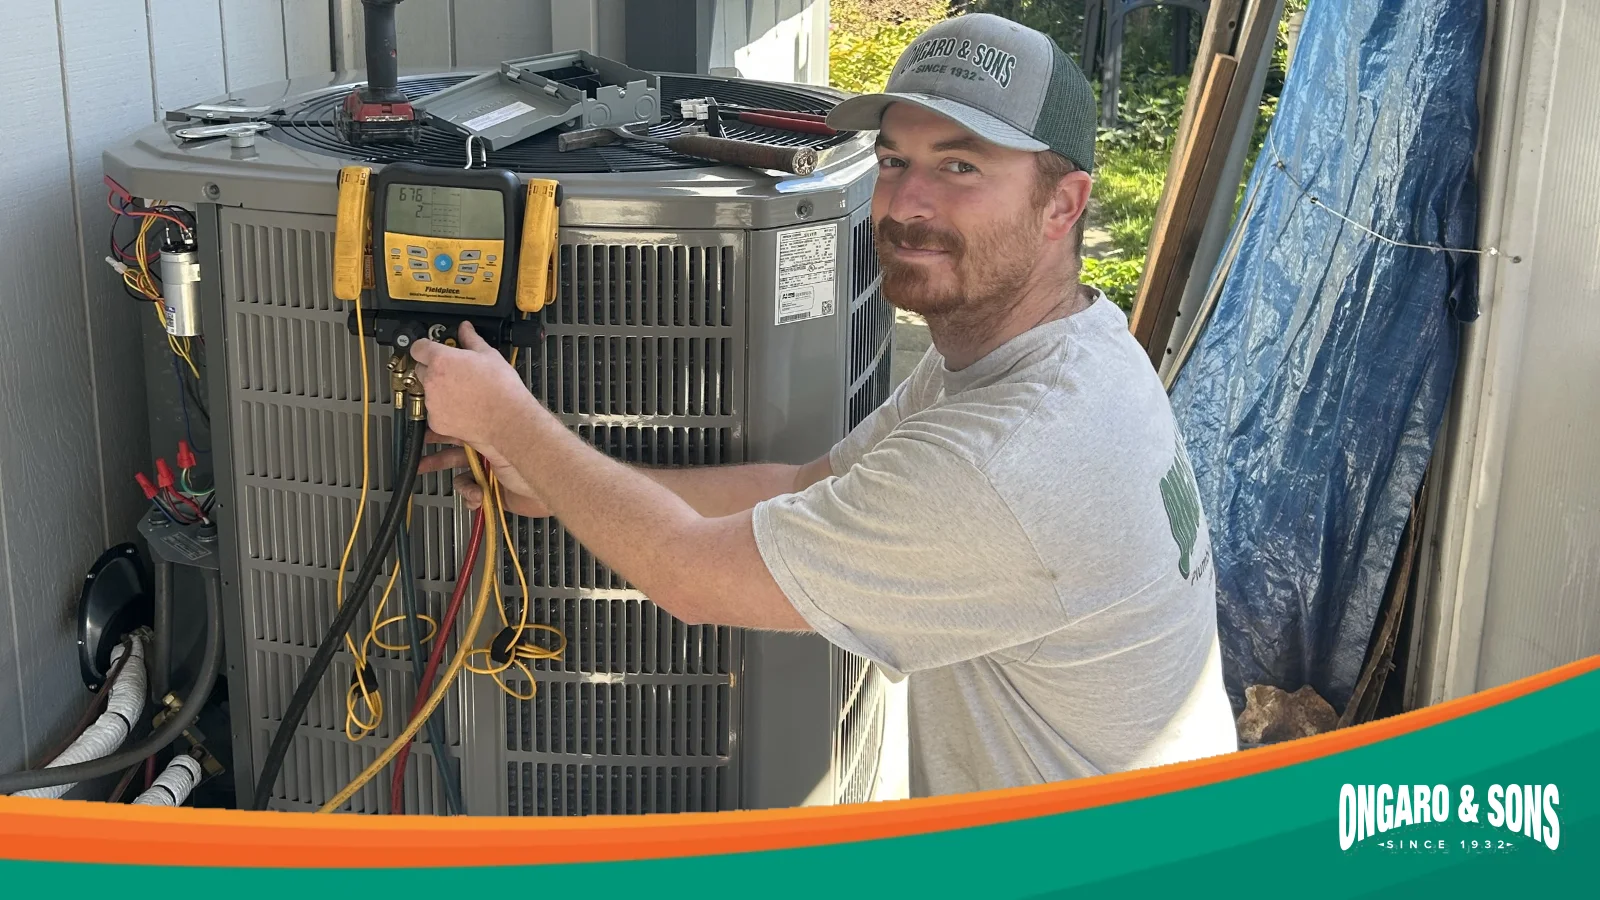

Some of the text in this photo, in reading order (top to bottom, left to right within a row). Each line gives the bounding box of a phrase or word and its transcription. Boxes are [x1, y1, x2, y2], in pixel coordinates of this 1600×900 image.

[956, 39, 972, 60] &
[971, 43, 1017, 89] SONS
[915, 64, 978, 81] SINCE 1932
[399, 187, 423, 202] 676
[416, 204, 424, 218] 2
[425, 286, 461, 295] Fieldpiece
